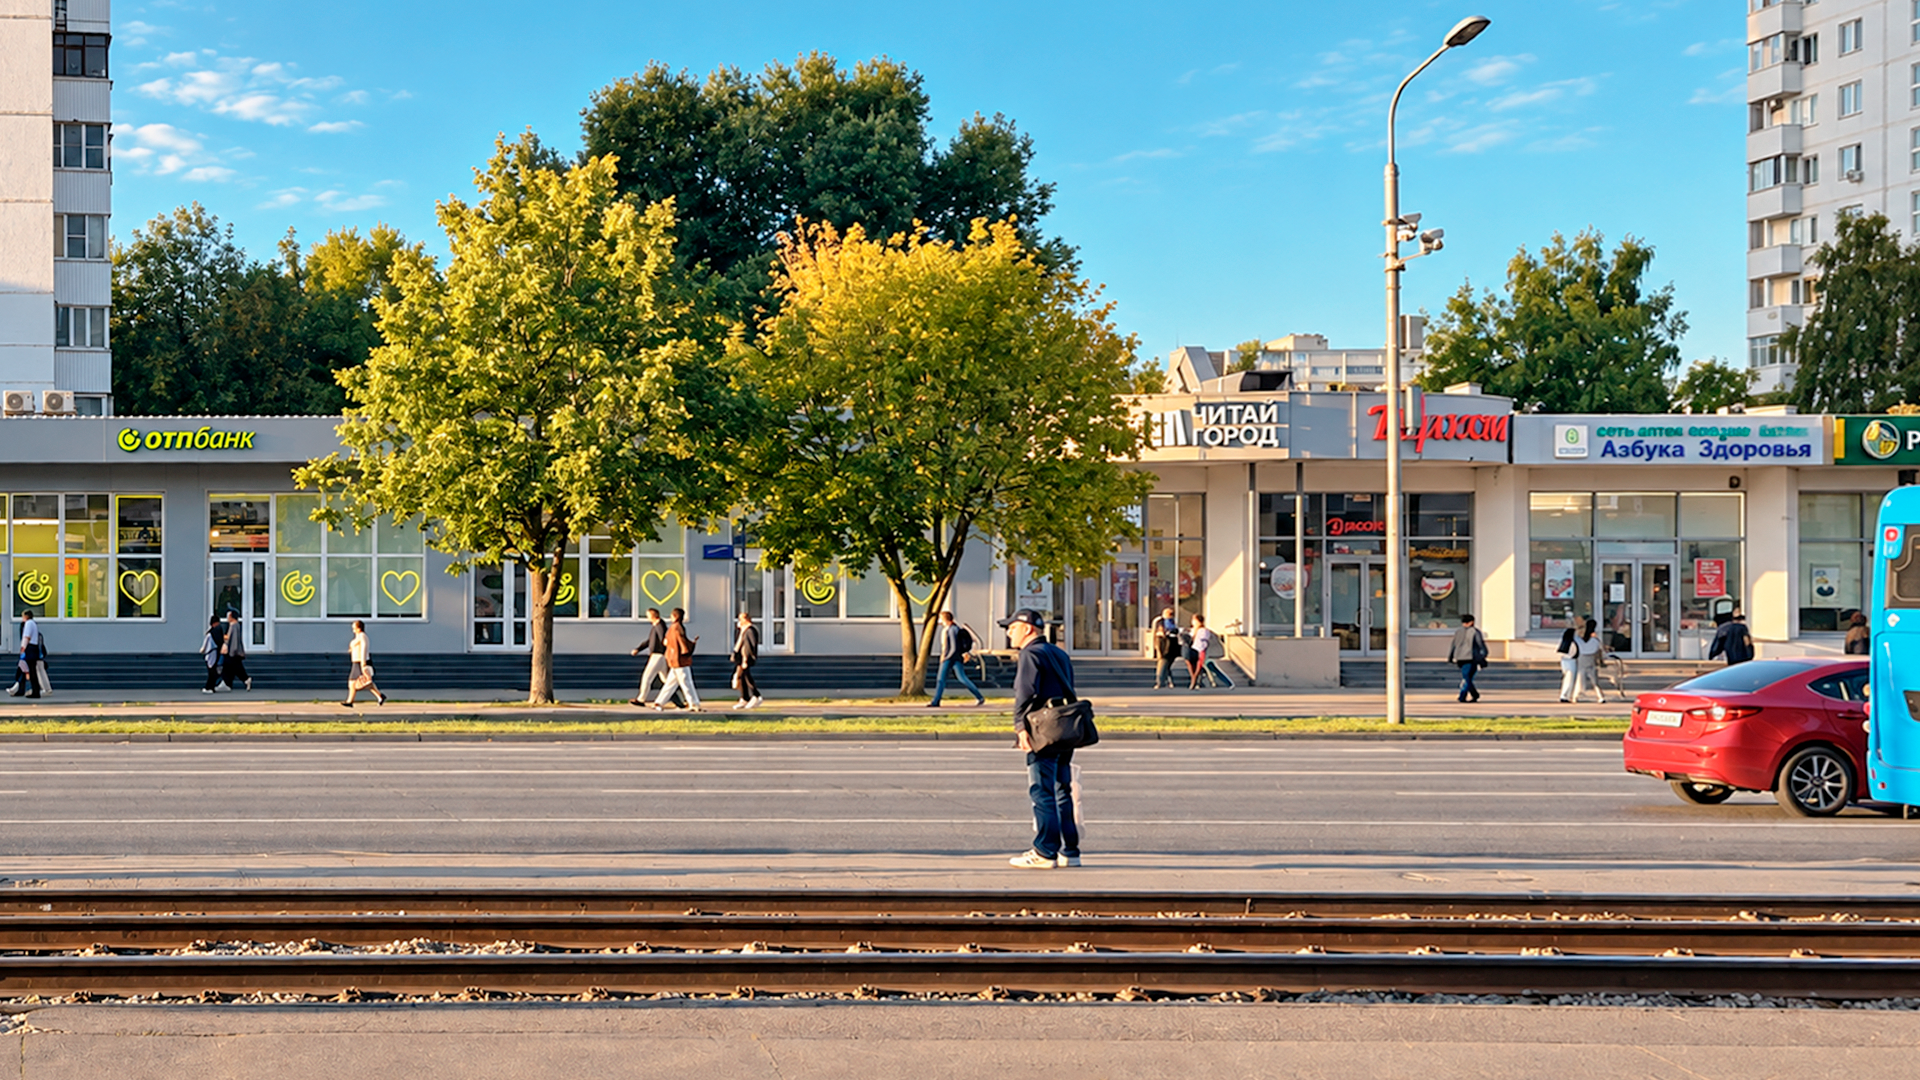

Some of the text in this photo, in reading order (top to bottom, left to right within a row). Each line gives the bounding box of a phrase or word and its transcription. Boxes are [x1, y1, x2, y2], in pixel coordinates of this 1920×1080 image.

[1193, 400, 1278, 425] ЧИТАЙ
[1192, 426, 1279, 448] ГОРОД
[1601, 439, 1811, 461] Азбука Здоровья
